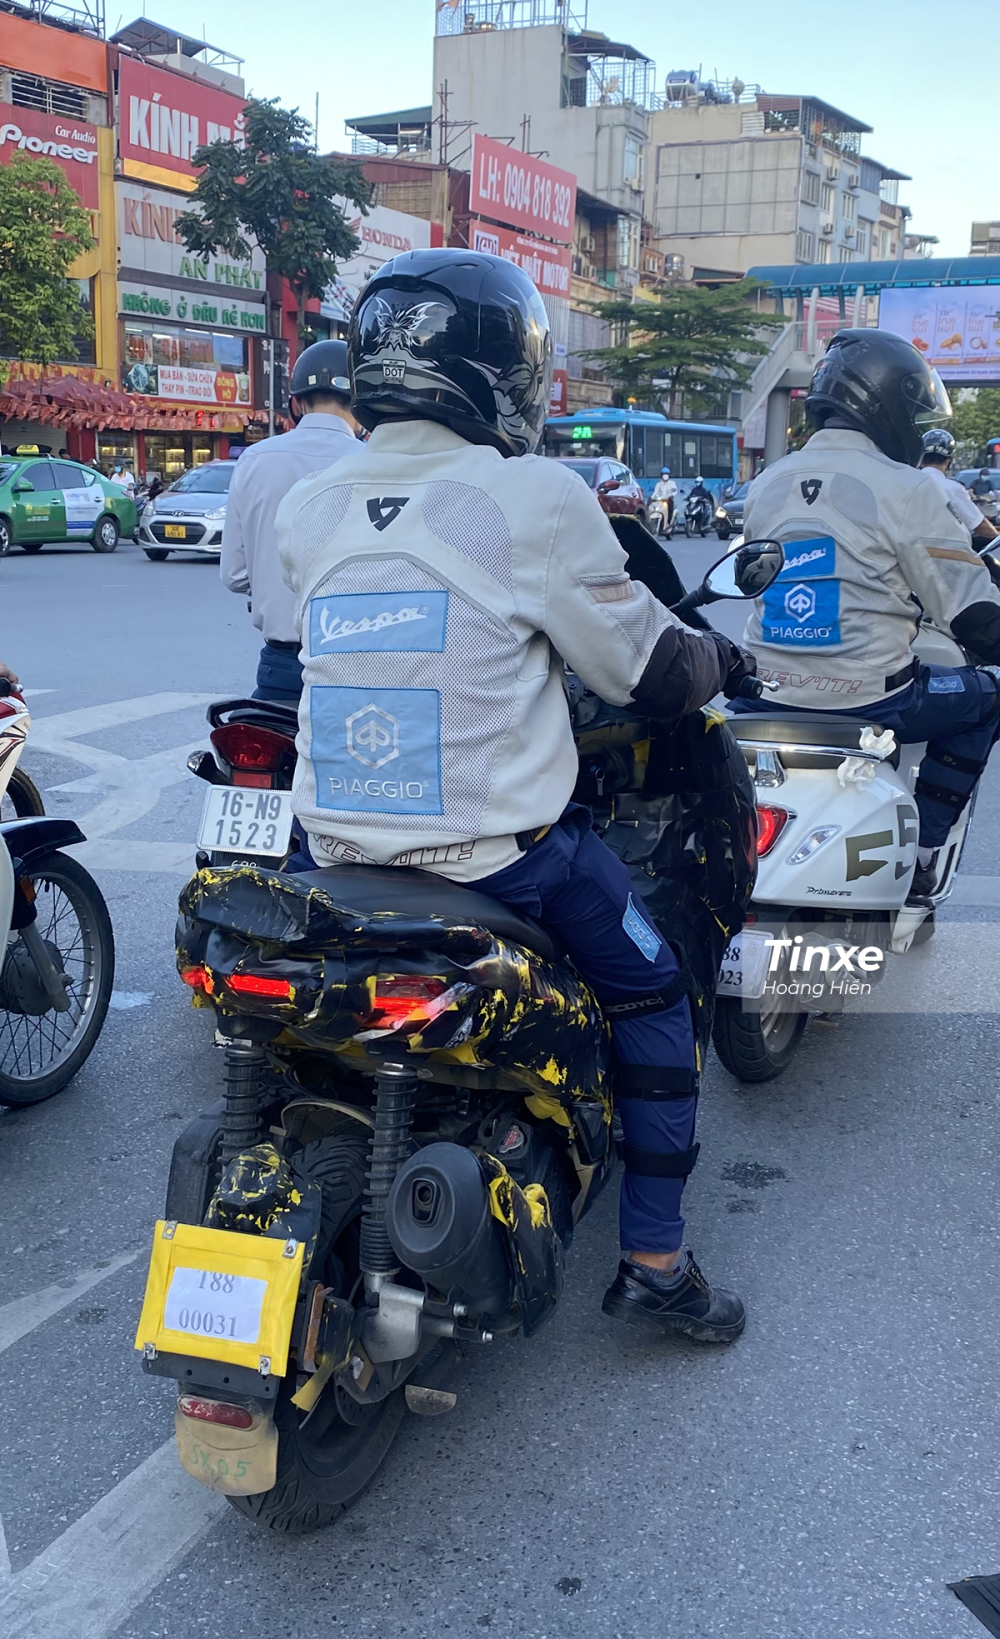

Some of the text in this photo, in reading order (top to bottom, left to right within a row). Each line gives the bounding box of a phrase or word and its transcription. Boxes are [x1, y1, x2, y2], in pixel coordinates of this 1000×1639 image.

[55, 125, 96, 144] Car Audio
[130, 93, 199, 162] KÍNH
[0, 124, 98, 164] Pioneer
[479, 153, 571, 228] LH: 0904 818 392
[362, 225, 412, 251] HONDA
[179, 257, 262, 289] AN PHÁT
[543, 261, 570, 291] MOTOR
[122, 291, 171, 316] KHÔNG
[192, 301, 218, 322] ĐÂU
[160, 370, 171, 379] MUA
[385, 367, 403, 377] DOT
[161, 383, 174, 393] THAY
[176, 385, 185, 394] PIN
[188, 385, 202, 396] TRAO
[780, 548, 827, 573] espa
[320, 605, 427, 645] Vespa
[770, 626, 830, 639] PIAGGIO
[329, 777, 423, 800] PIAGGIO
[221, 791, 282, 820] 16-N9
[216, 819, 277, 850] 1523
[179, 1307, 237, 1337] 00031
